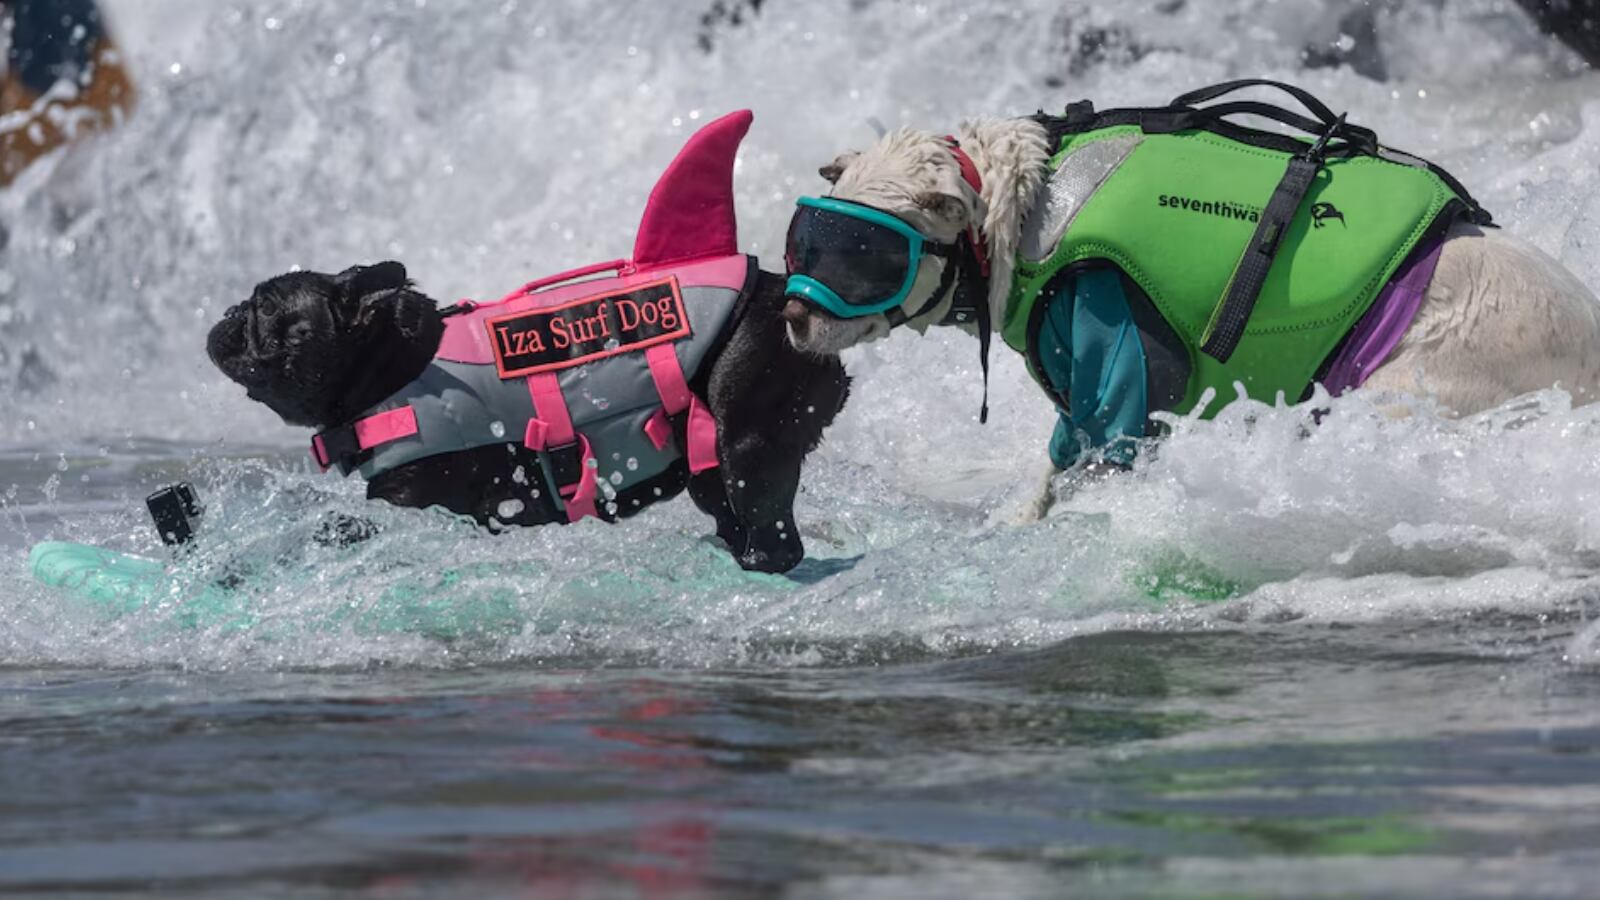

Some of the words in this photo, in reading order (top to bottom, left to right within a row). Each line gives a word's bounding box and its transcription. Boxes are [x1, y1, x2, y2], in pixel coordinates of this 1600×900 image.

[1158, 194, 1259, 223] seventhwa
[497, 327, 546, 357] Iza
[549, 303, 610, 350] Surf
[615, 296, 678, 332] Dog
